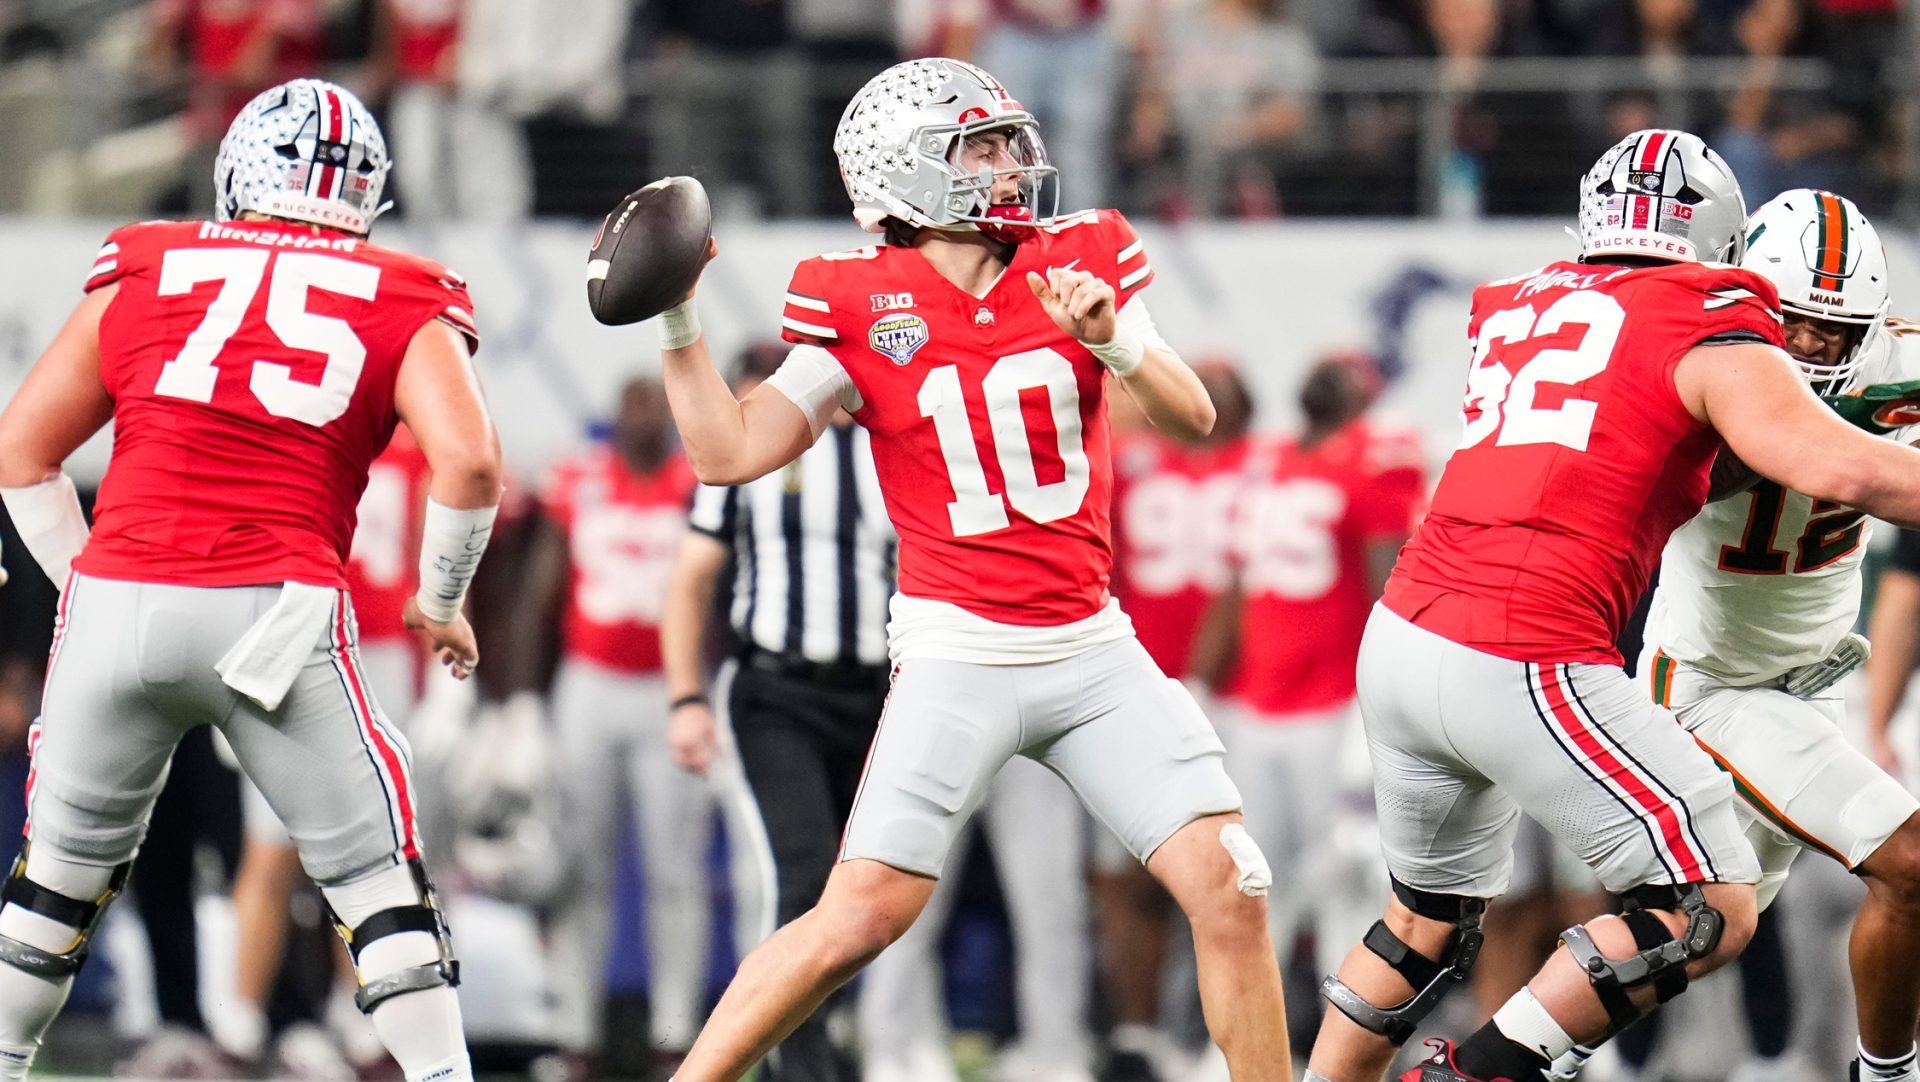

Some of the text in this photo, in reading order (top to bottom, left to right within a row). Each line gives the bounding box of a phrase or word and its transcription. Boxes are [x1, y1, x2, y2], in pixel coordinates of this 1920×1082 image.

[272, 202, 361, 226] BUCKEYES
[1607, 215, 1620, 226] 62
[1594, 238, 1687, 255] BUCKEYES
[1809, 292, 1844, 307] MIAMI
[154, 248, 381, 428] 75
[874, 325, 924, 347] COTTON
[884, 337, 916, 351] BOWL
[1457, 286, 1626, 452] 62
[916, 346, 1090, 537] 10
[1716, 478, 1865, 576] 12
